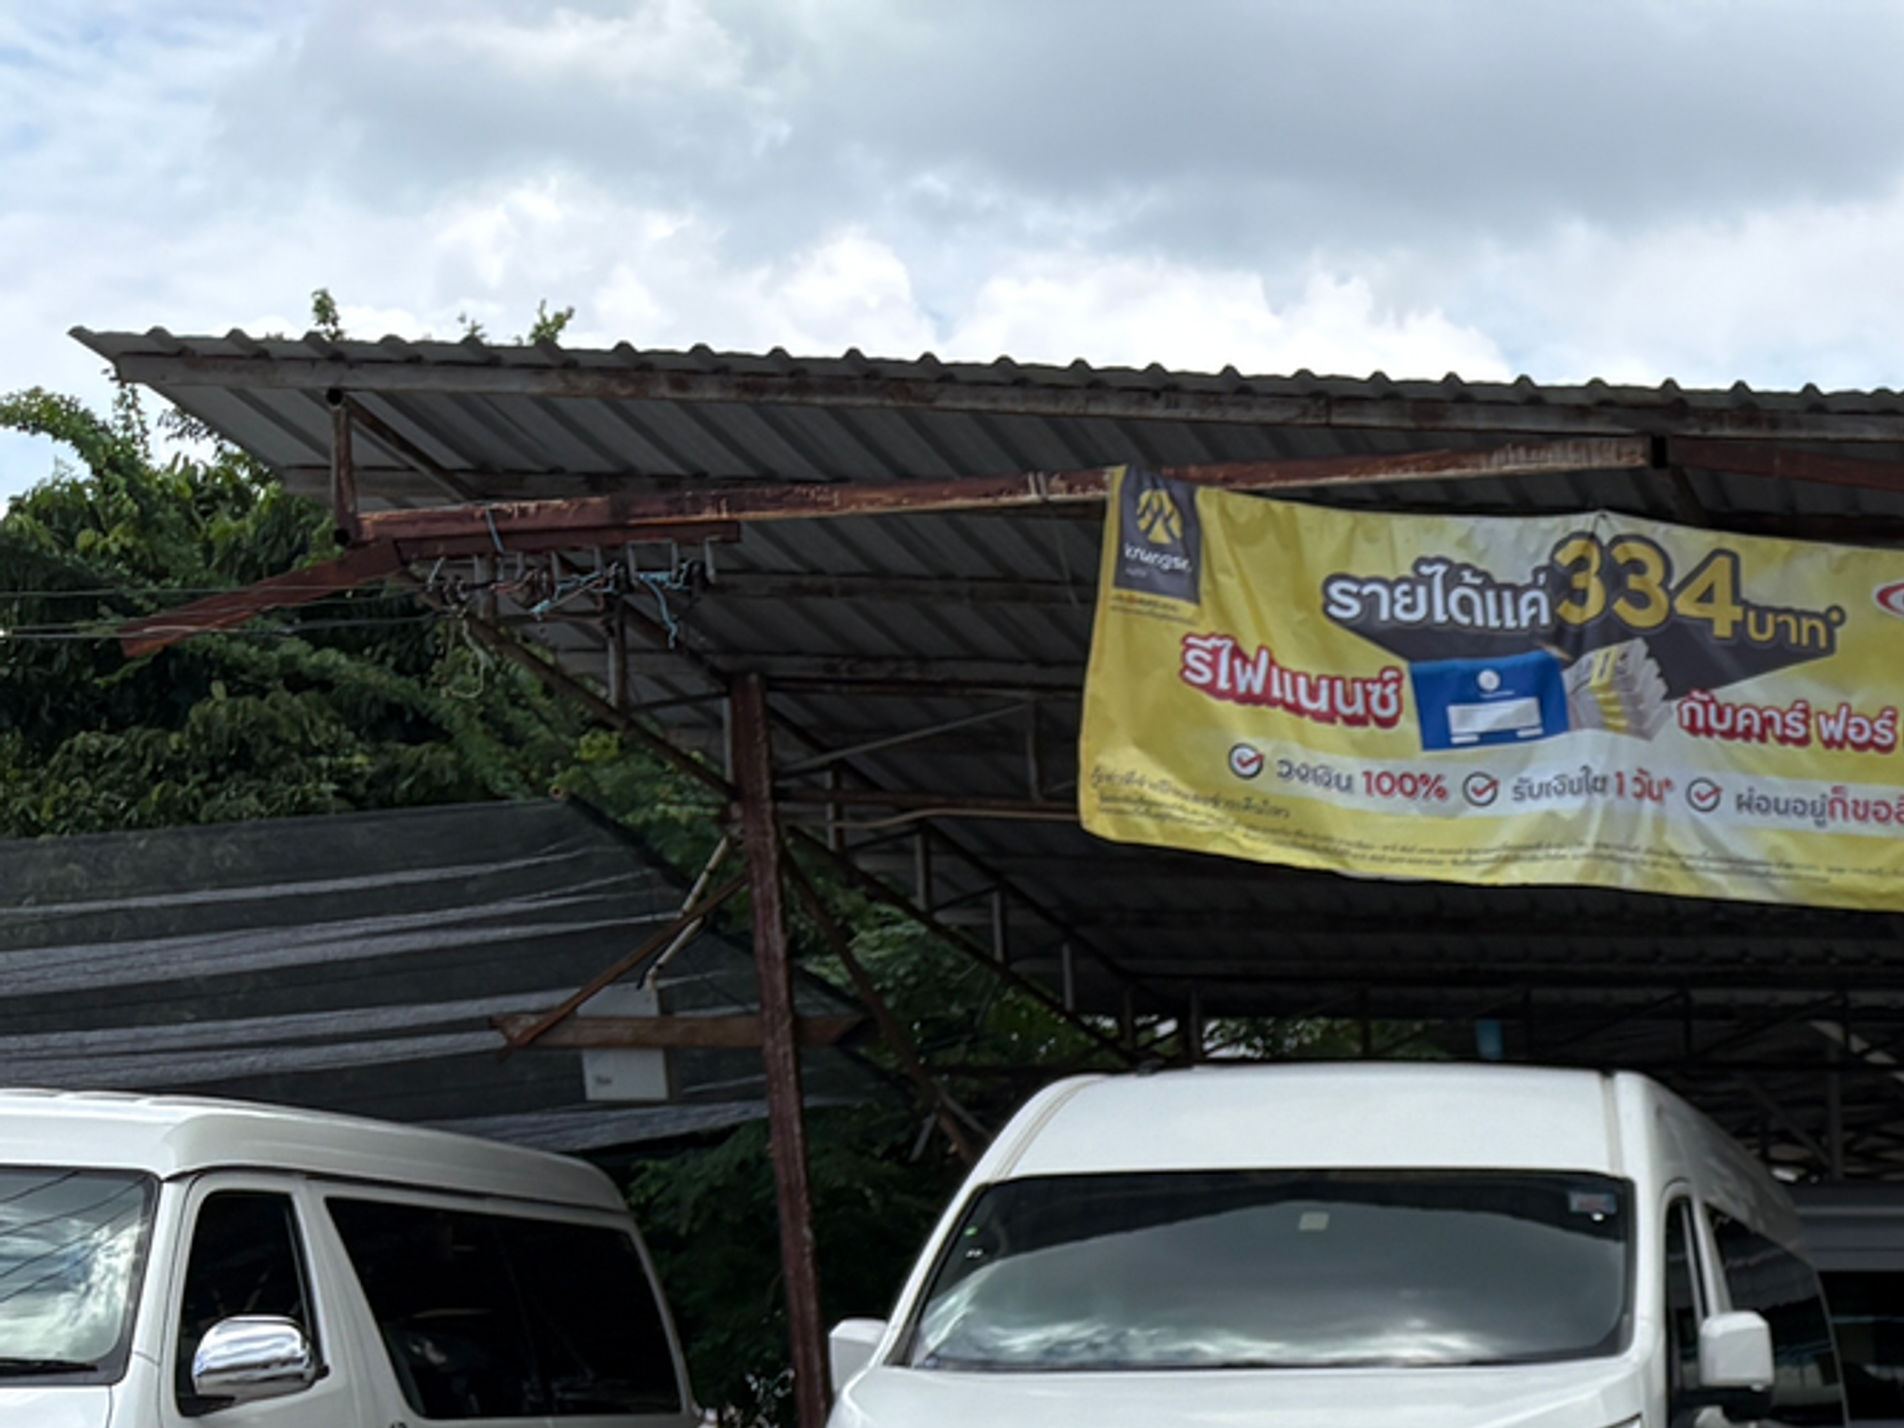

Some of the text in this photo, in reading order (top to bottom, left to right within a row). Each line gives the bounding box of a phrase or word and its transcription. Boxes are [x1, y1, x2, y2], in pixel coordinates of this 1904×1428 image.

[1325, 562, 1552, 630] รายได้แค่
[1552, 537, 1743, 639] 334
[1182, 634, 1402, 721] รีไฟแนนซ์
[1680, 691, 1807, 740] กับคาร์
[1817, 704, 1897, 747] ฟอร์
[1363, 769, 1449, 800] 100%
[1614, 771, 1625, 797] 1
